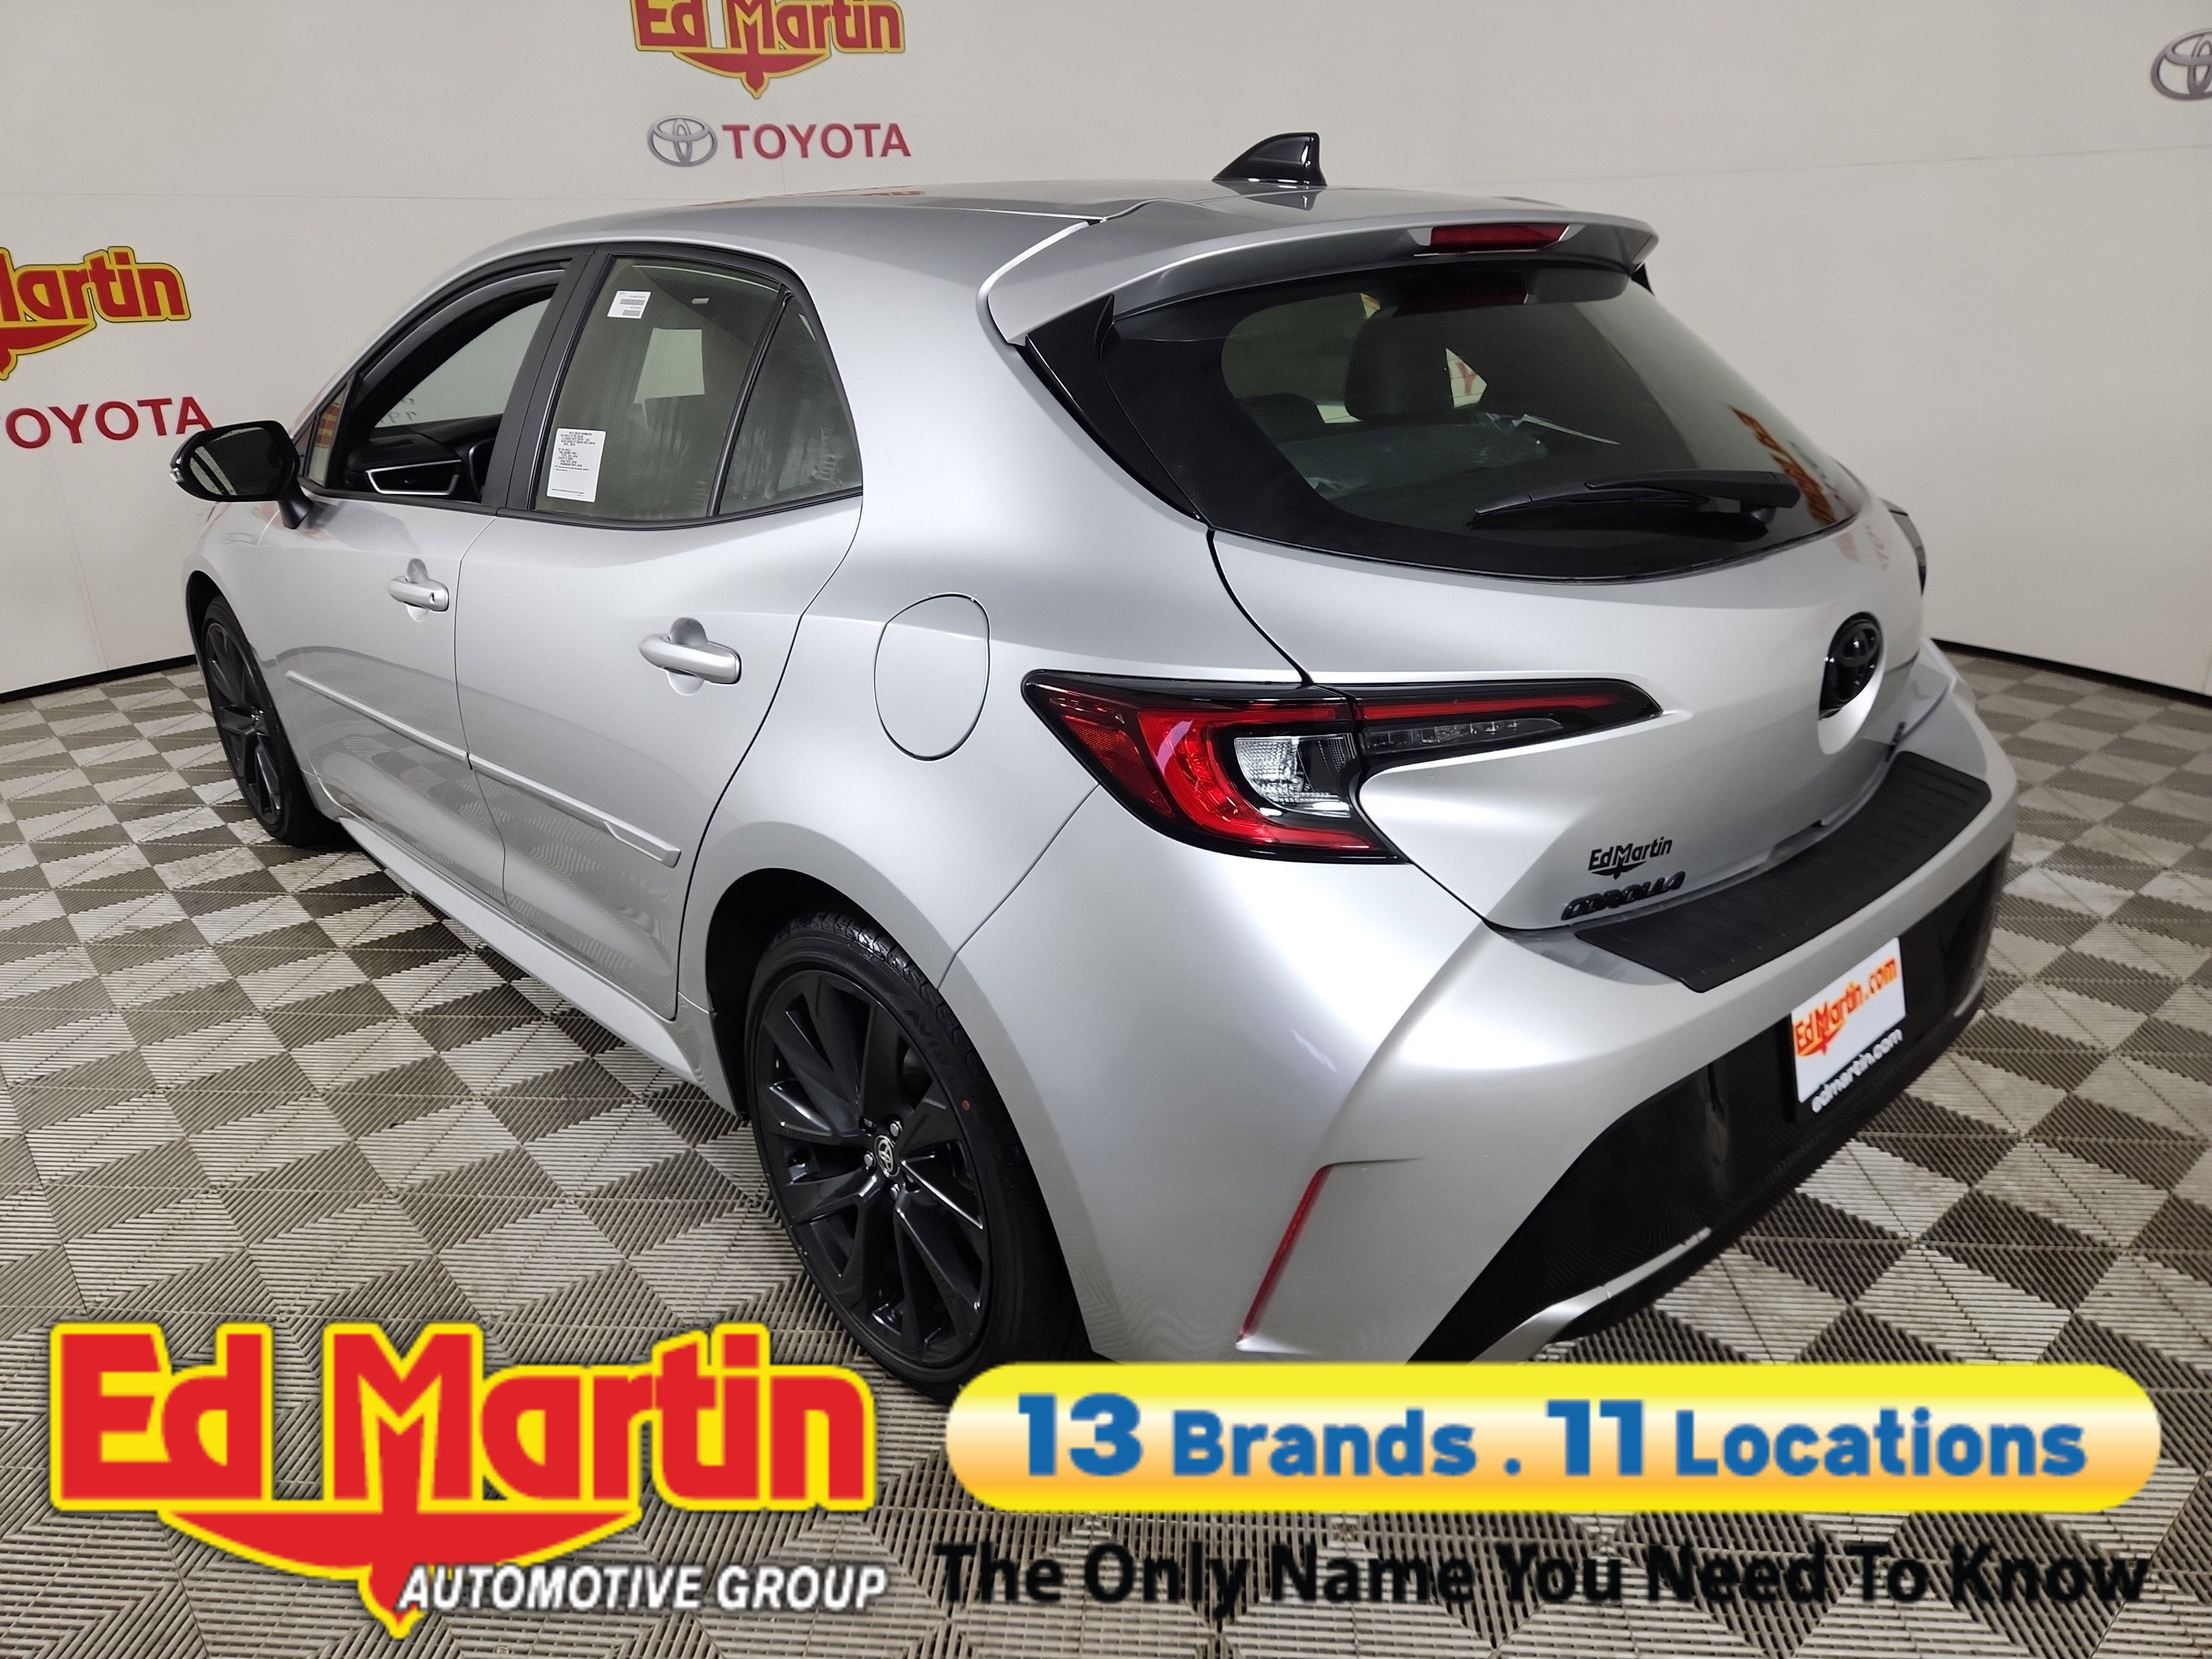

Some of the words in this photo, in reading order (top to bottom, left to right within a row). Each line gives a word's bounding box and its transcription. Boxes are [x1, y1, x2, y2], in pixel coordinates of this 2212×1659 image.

[632, 0, 709, 50] Ed
[724, 0, 903, 51] Martin
[723, 123, 911, 159] TOYOTA
[5, 396, 214, 449] OYOTA
[1560, 870, 1686, 921] COROLLA
[1811, 1028, 1904, 1113] edmartin.com
